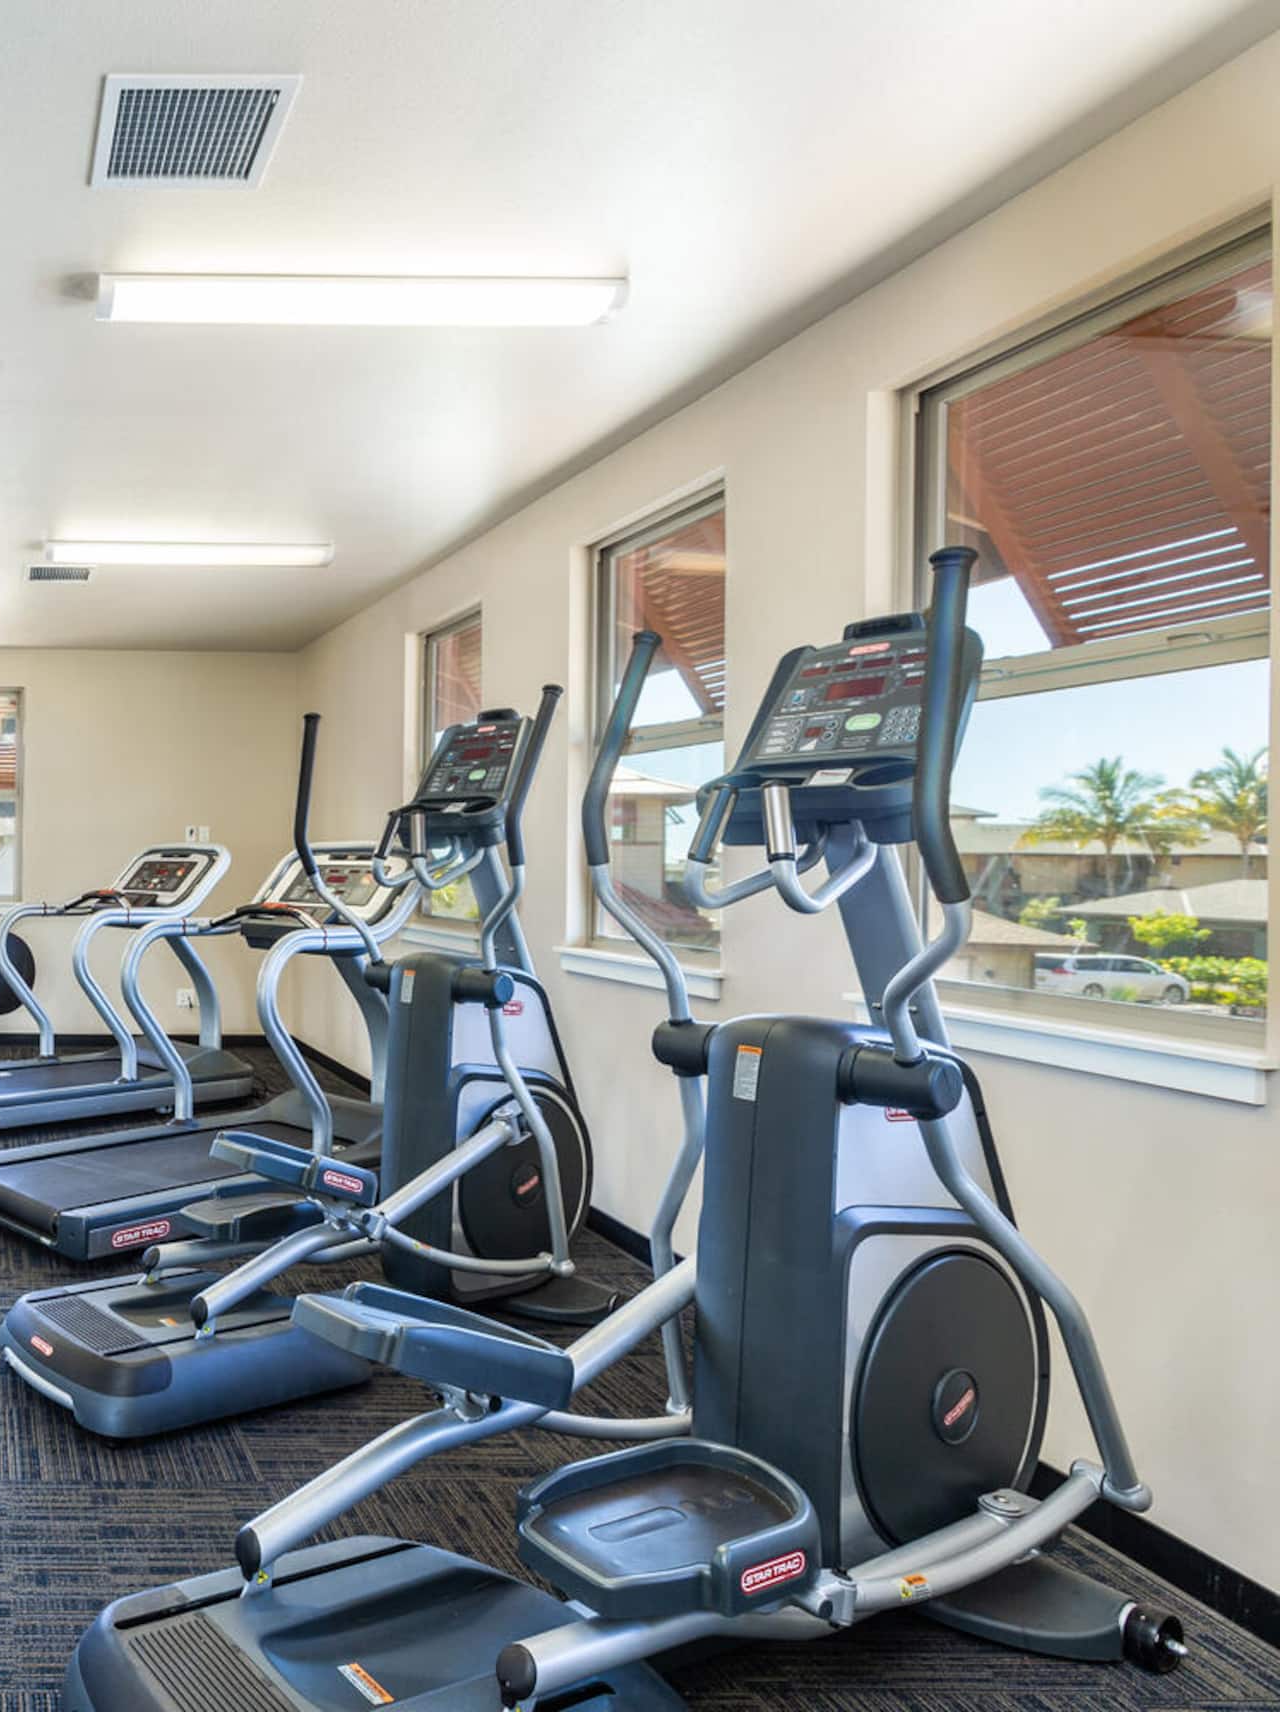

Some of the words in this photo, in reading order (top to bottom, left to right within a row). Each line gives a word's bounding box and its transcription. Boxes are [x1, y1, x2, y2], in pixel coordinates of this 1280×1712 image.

[116, 1230, 140, 1242] STAR
[141, 1225, 166, 1236] TRAC
[745, 1567, 772, 1586] STAR
[773, 1557, 801, 1577] TRAC
